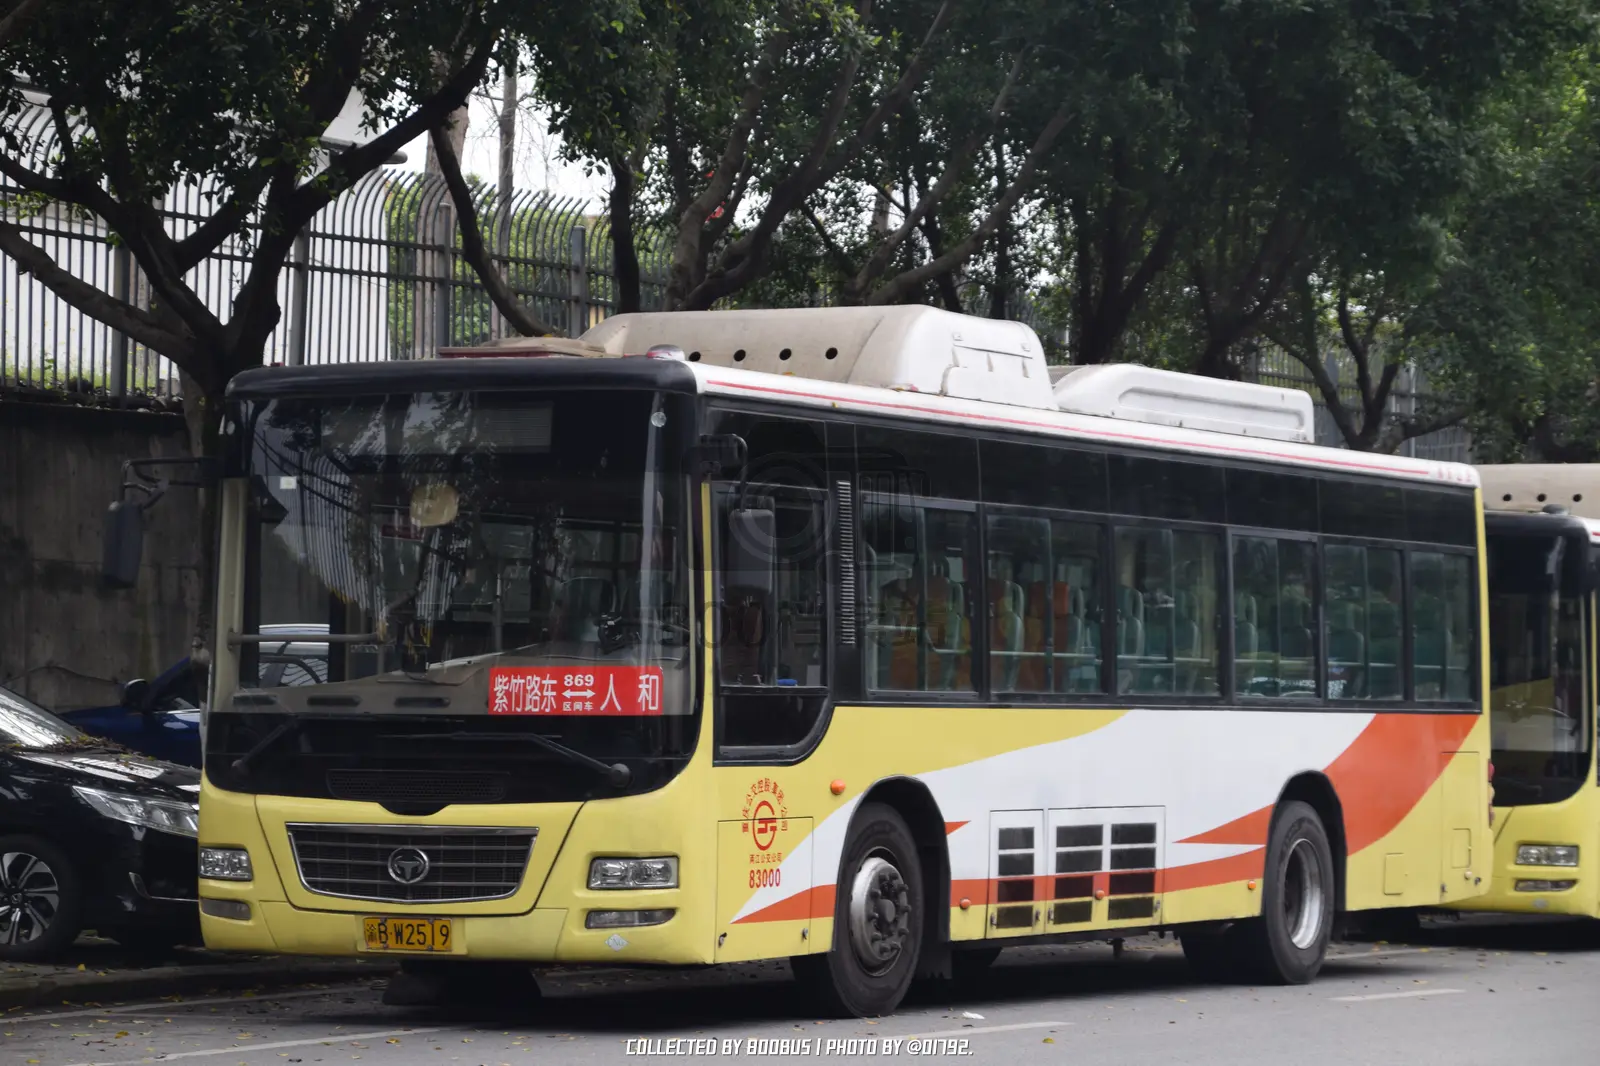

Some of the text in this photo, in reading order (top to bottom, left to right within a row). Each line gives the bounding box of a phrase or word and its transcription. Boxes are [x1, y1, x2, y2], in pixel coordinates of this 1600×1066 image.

[563, 674, 595, 687] 869
[493, 673, 558, 713] 紫竹路东
[562, 701, 594, 712] 区间车
[748, 867, 781, 888] 83000
